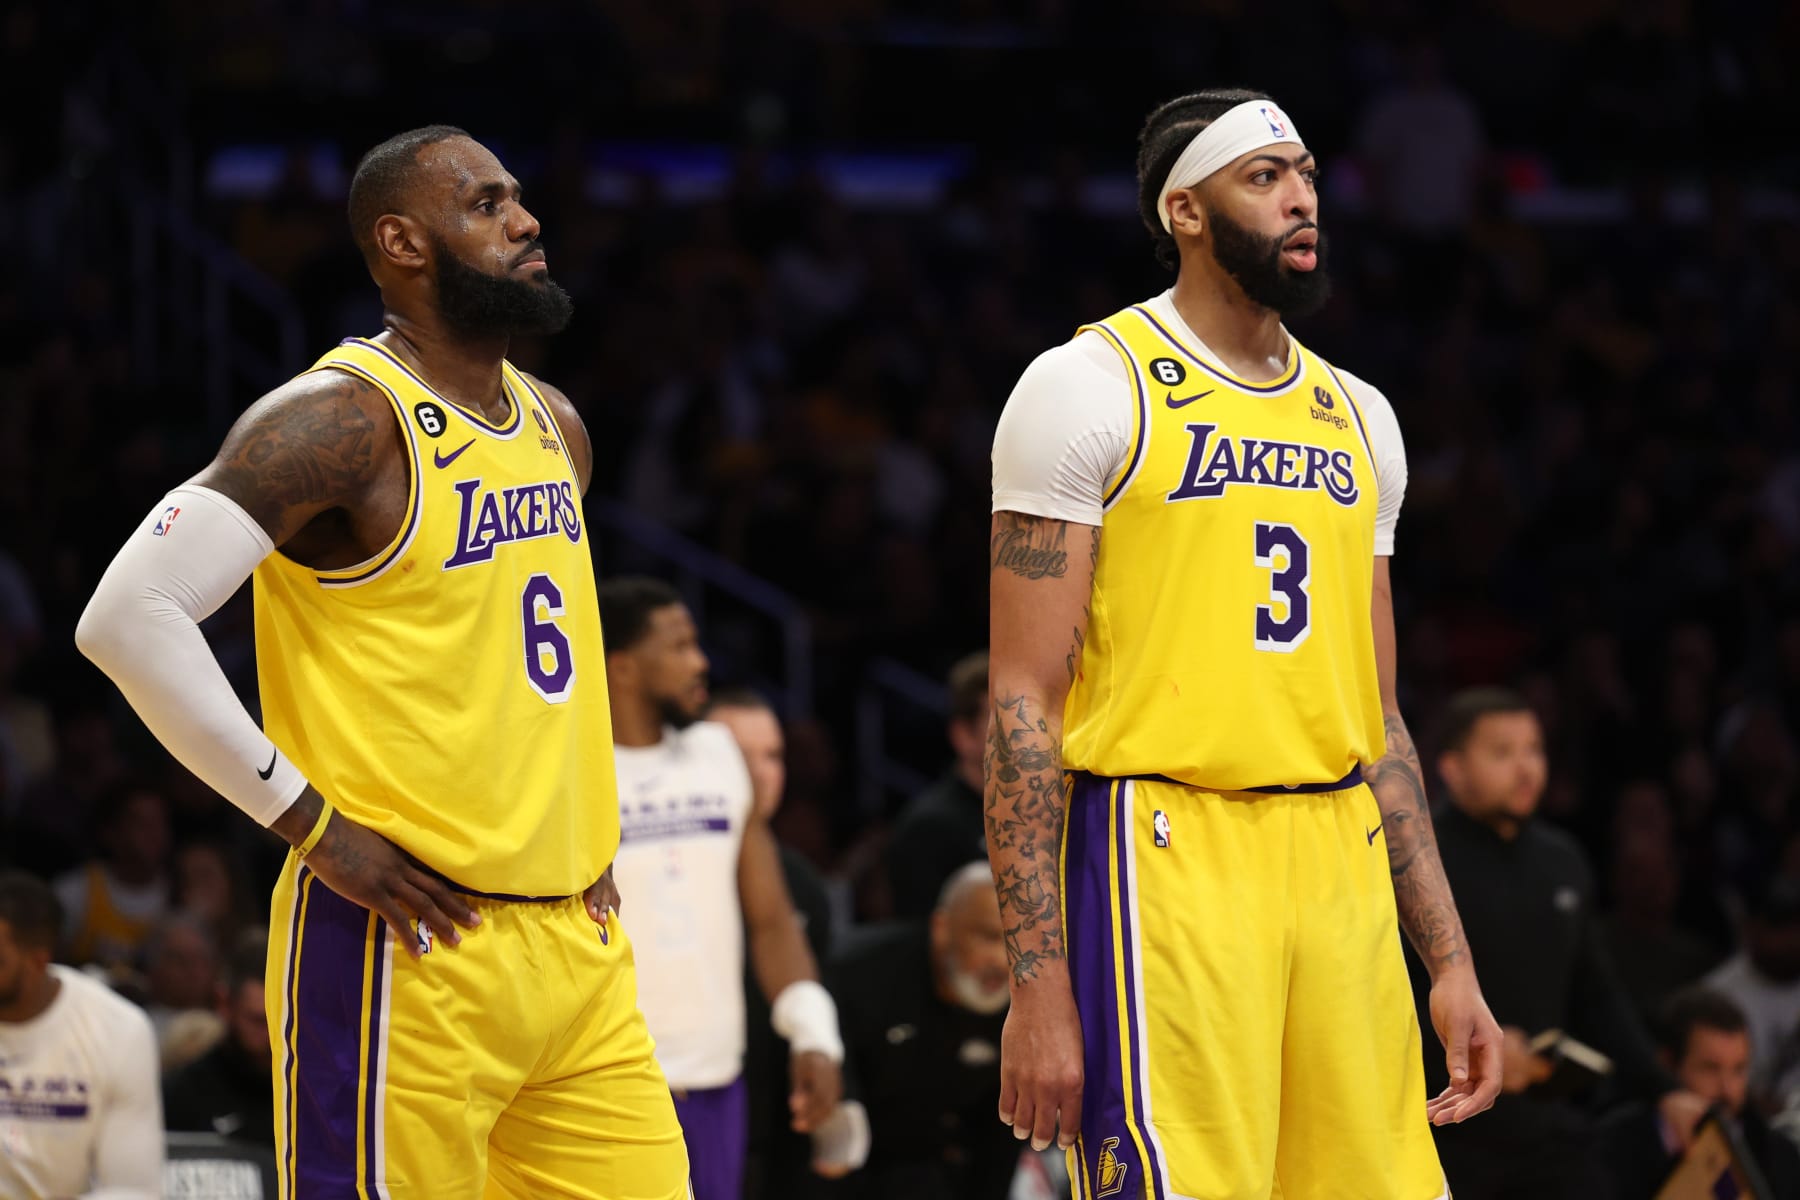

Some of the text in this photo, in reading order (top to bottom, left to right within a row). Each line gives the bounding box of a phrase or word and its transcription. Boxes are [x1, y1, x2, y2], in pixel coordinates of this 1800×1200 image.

[1156, 361, 1179, 382] 6
[418, 407, 440, 433] 6
[1310, 406, 1348, 429] bibigo
[1166, 423, 1359, 507] LAKERS
[442, 476, 581, 571] LAKERS
[1254, 520, 1311, 653] 3
[521, 572, 576, 704] 6
